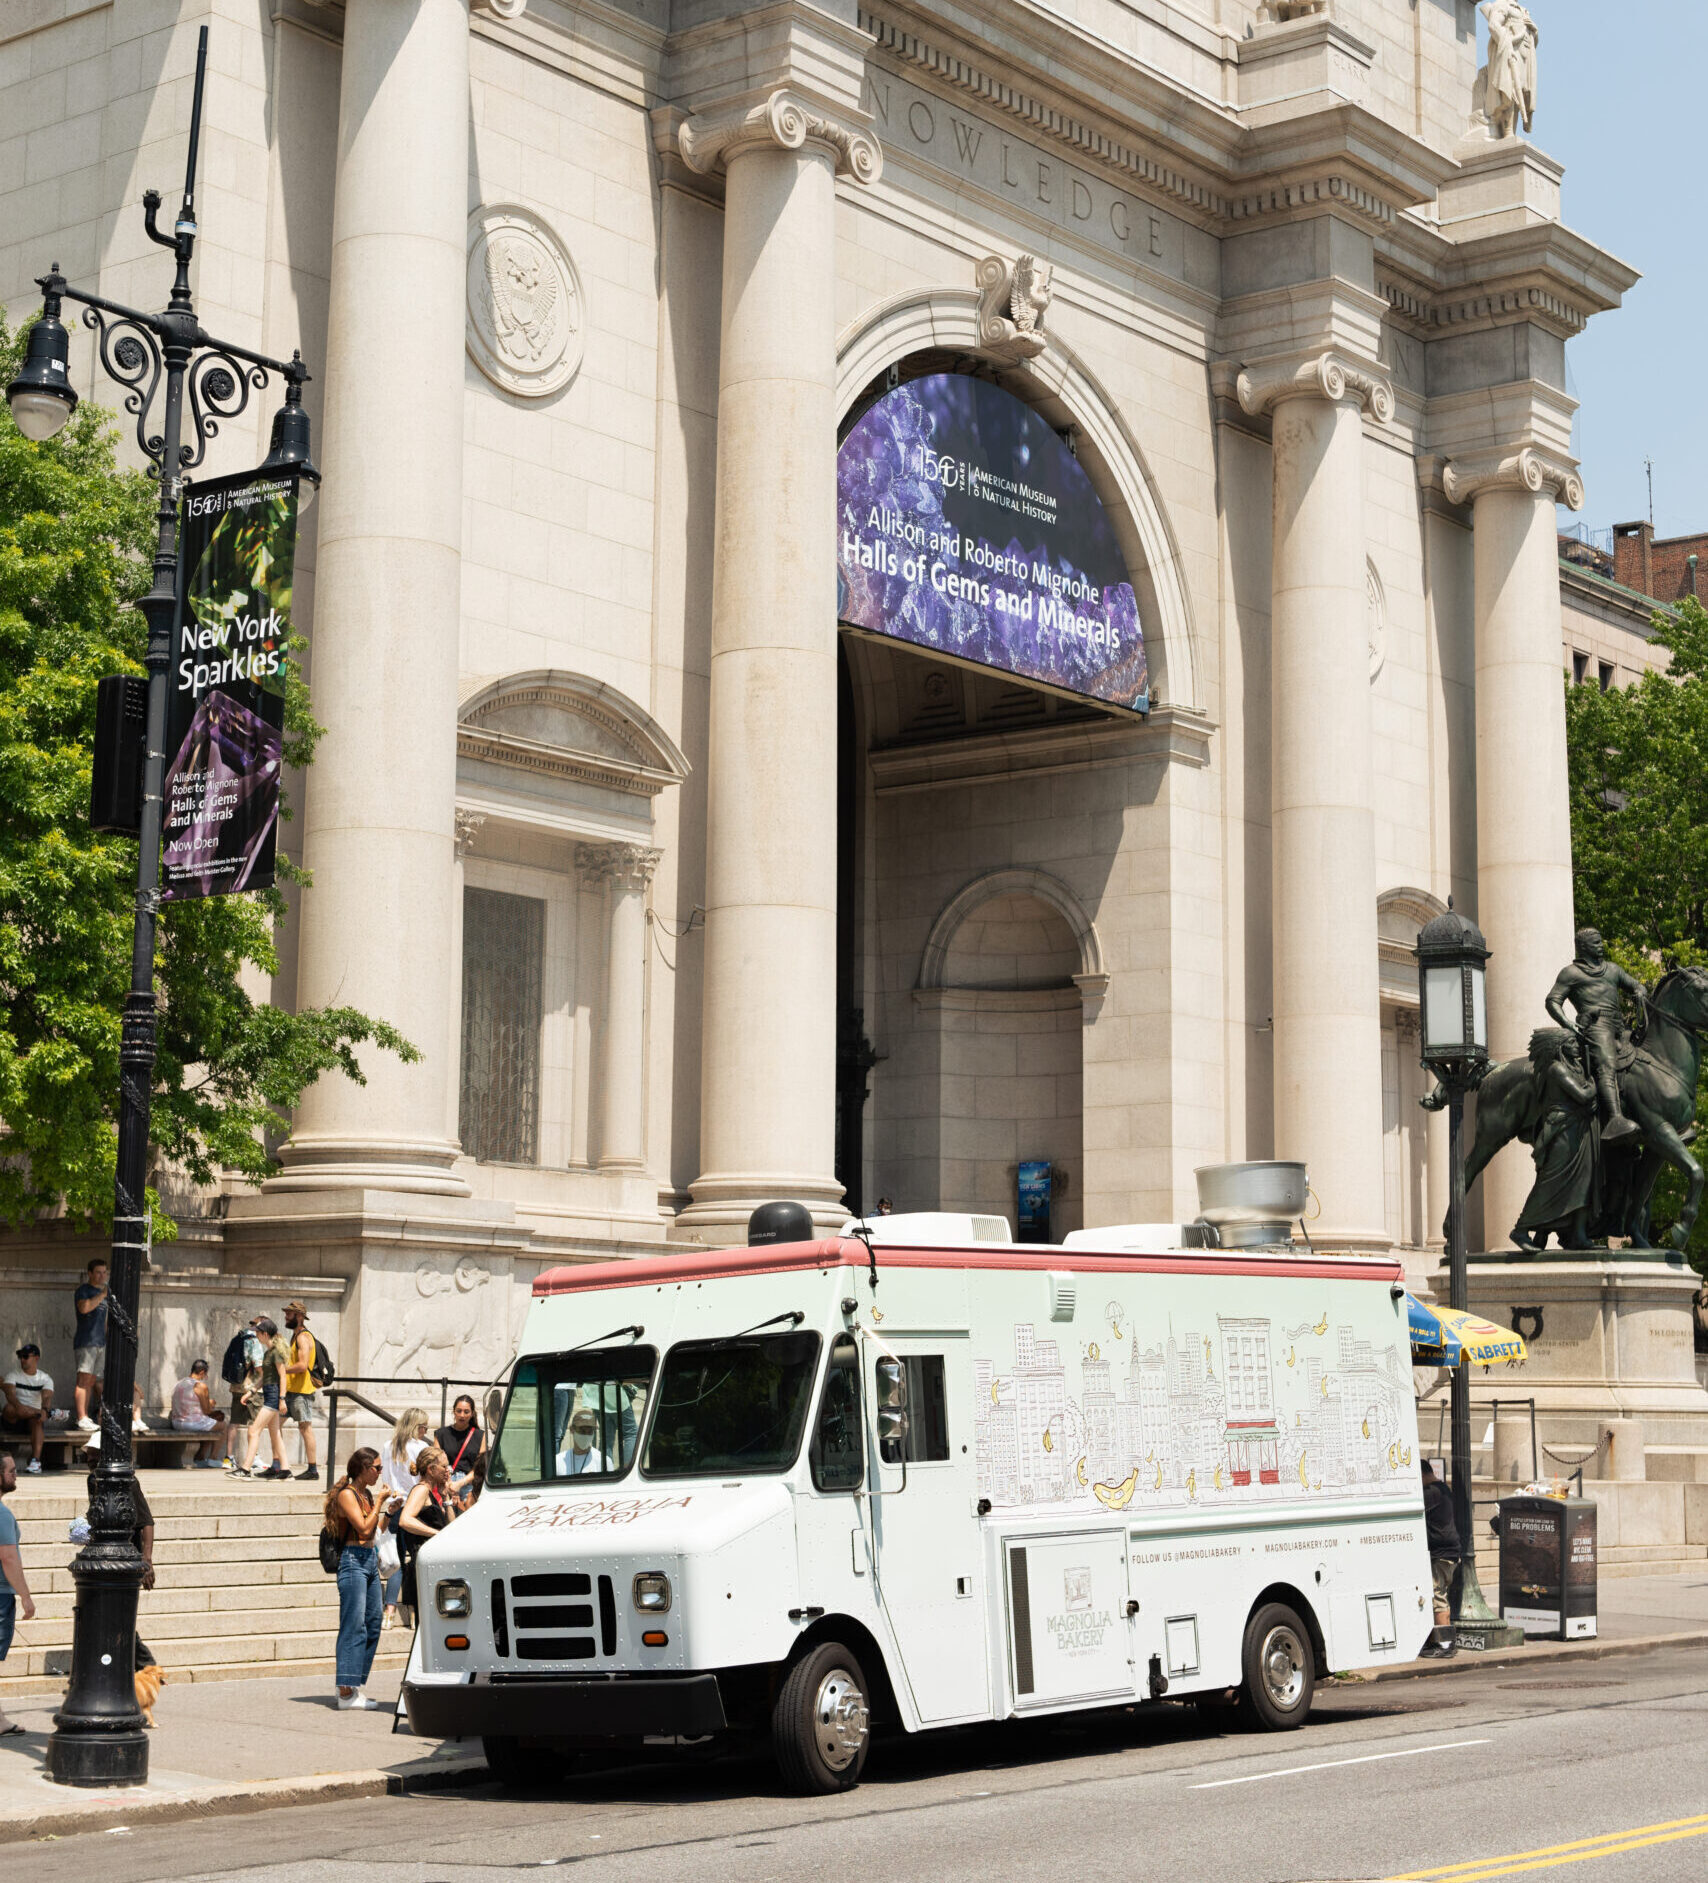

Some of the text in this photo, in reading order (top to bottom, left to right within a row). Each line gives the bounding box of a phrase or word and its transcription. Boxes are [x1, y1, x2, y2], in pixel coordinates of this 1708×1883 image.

[867, 76, 1163, 258] NOWLEDGE
[227, 480, 292, 499] AMERICAN MUSEUM
[973, 466, 1057, 509] AMERICAN MUSEUM
[233, 497, 262, 508] NATURAL
[263, 490, 292, 501] HISTORY
[982, 486, 1021, 512] NATURAL
[1022, 500, 1057, 525] HISTORY
[868, 505, 1099, 605] Allison and Roberto Mignone
[843, 530, 1121, 649] Halls of Gems and Minerals
[181, 608, 282, 653] New York
[178, 645, 279, 698] Sparkles
[172, 772, 200, 783] Allison
[171, 797, 196, 812] Halls
[211, 793, 238, 807] Gems
[170, 806, 233, 827] and Minerals
[169, 837, 219, 853] Now Open
[1469, 1341, 1521, 1361] SABRETT
[507, 1495, 695, 1517] MAGNOLIA
[508, 1510, 653, 1529] BAKERY
[1510, 1522, 1556, 1532] BIG PROBLEMS
[1264, 1538, 1338, 1553] MAGNOLIABAKERY.COM
[1359, 1532, 1414, 1545] #MBSWEEPSTAKES
[1132, 1546, 1241, 1565] FOLLOW US @MAGNOLIABAKERY
[1046, 1610, 1113, 1633] MAGNOLIA
[1057, 1629, 1105, 1650] BAKERY
